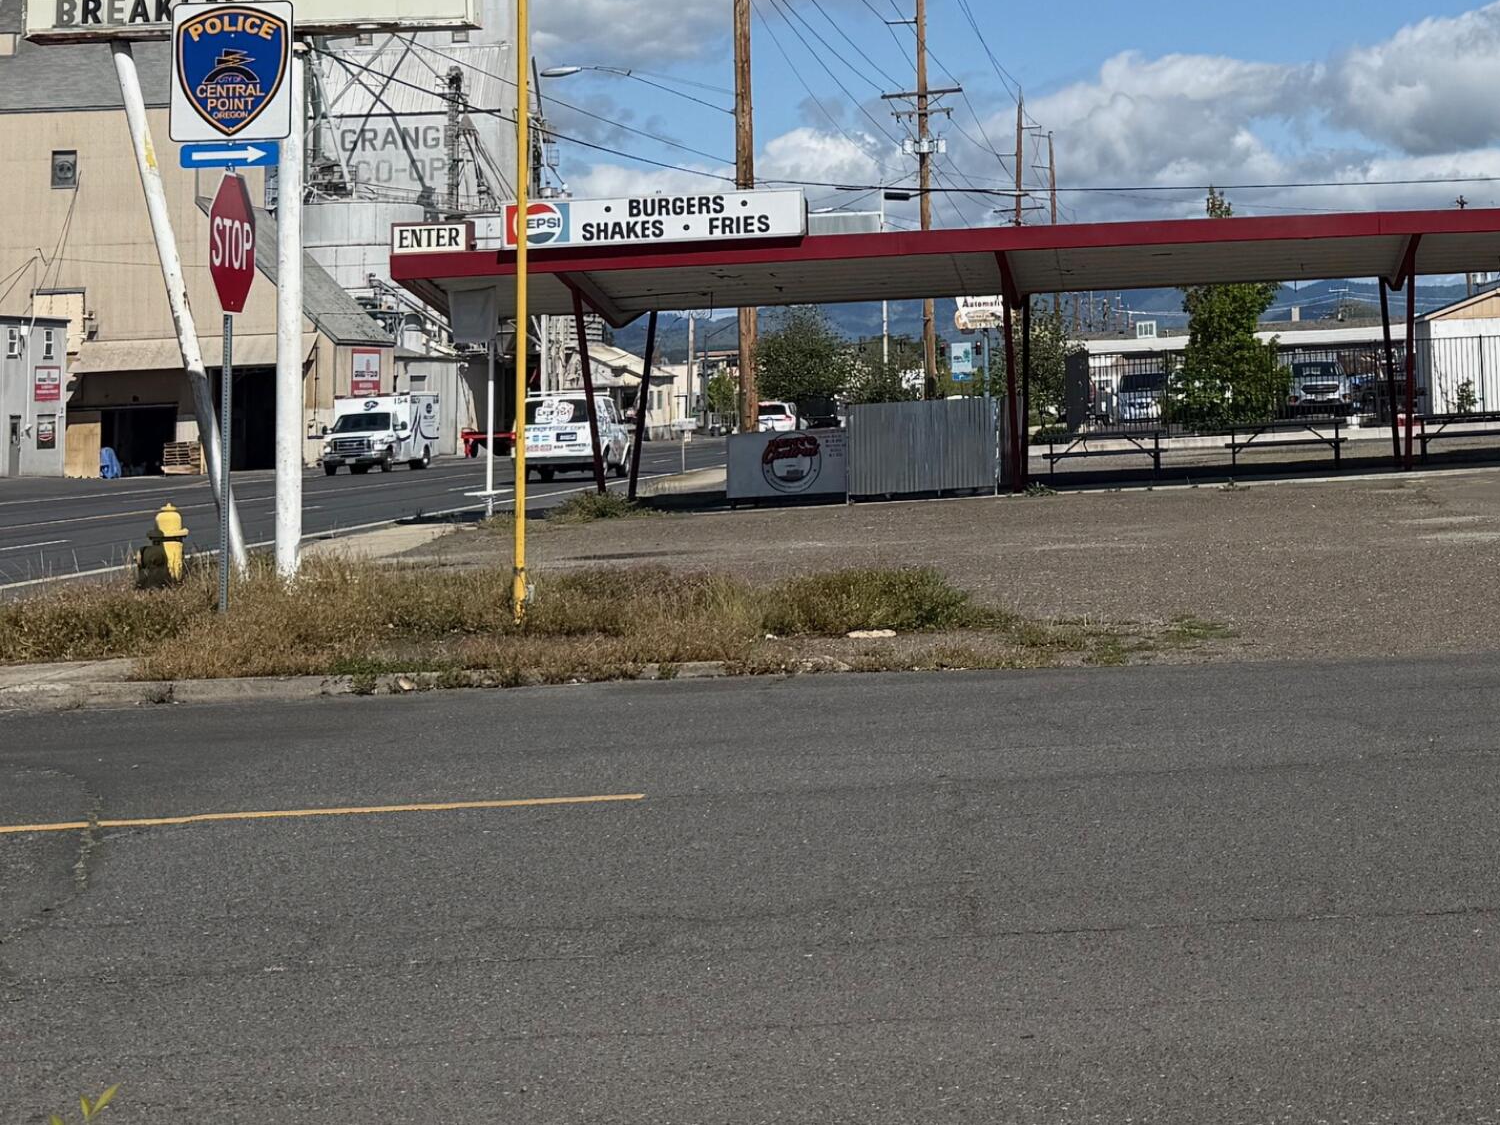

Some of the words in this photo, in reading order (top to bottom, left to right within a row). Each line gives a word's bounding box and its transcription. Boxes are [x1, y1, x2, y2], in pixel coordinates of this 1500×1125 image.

[188, 15, 278, 42] POLICE
[196, 83, 265, 98] CENTRAL
[218, 76, 232, 84] CITY
[207, 97, 255, 112] POINT
[213, 110, 249, 120] OREGON
[355, 157, 446, 183] CO-OP
[628, 195, 725, 217] BURGERS
[526, 217, 561, 229] EPSI
[582, 220, 664, 241] SHAKES
[709, 215, 770, 236] FRIES
[212, 216, 252, 270] STOP
[399, 227, 460, 248] ENTER
